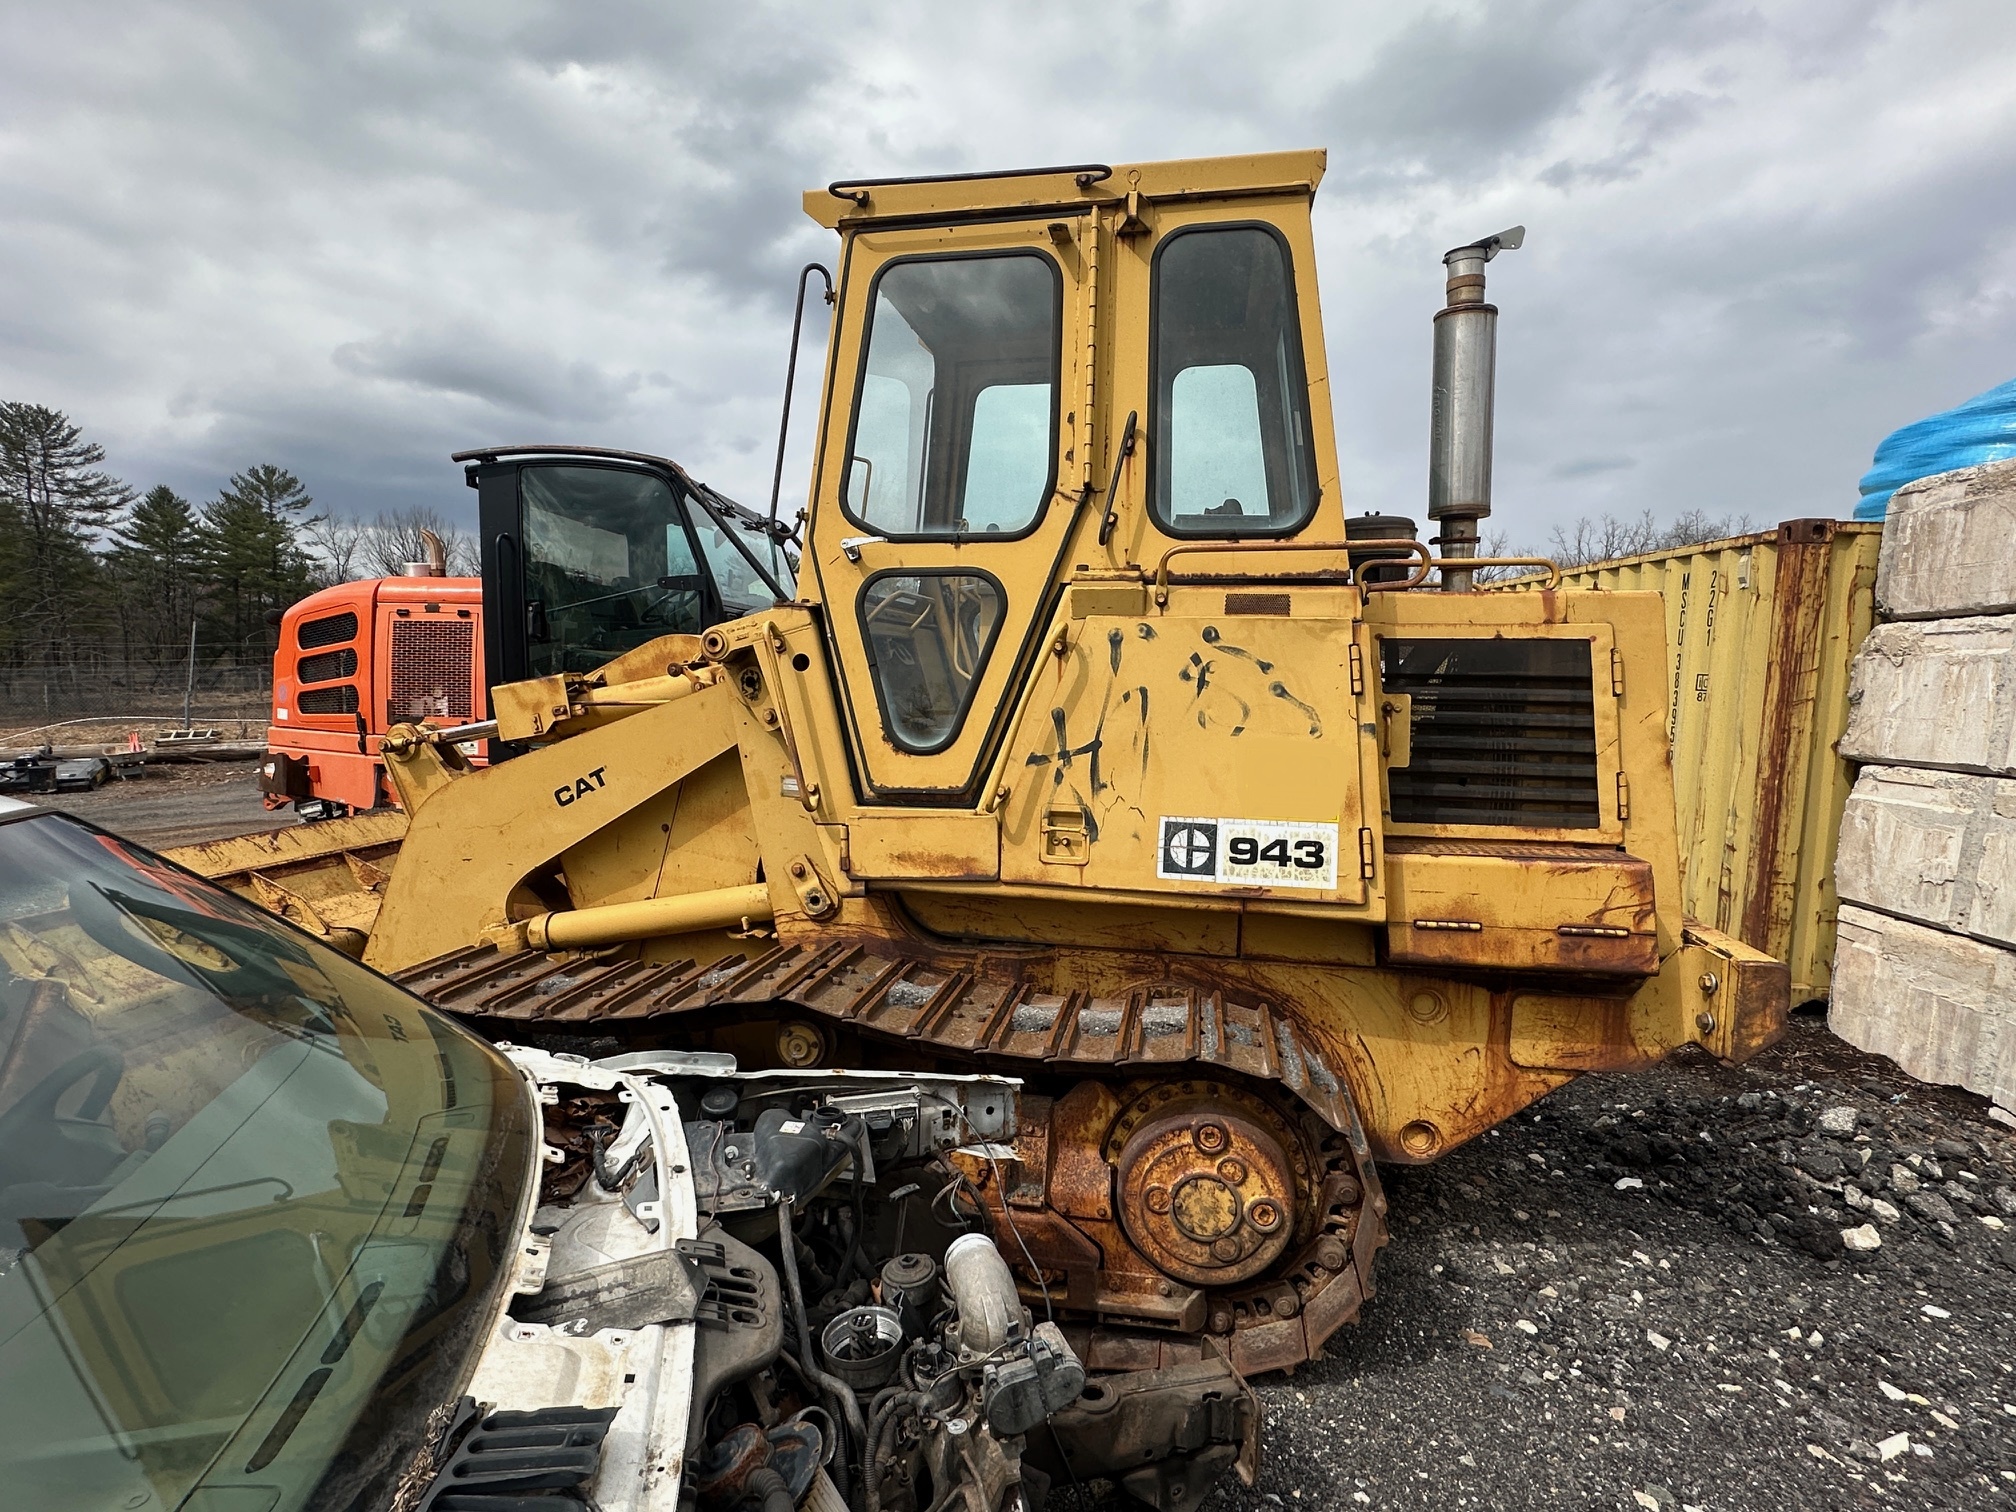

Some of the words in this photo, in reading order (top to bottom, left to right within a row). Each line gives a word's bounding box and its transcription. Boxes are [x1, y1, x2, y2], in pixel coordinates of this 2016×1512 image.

[1677, 573, 1690, 646] MSCU
[1706, 570, 1717, 646] 22G1
[554, 766, 606, 807] CAT
[1229, 837, 1324, 868] 943
